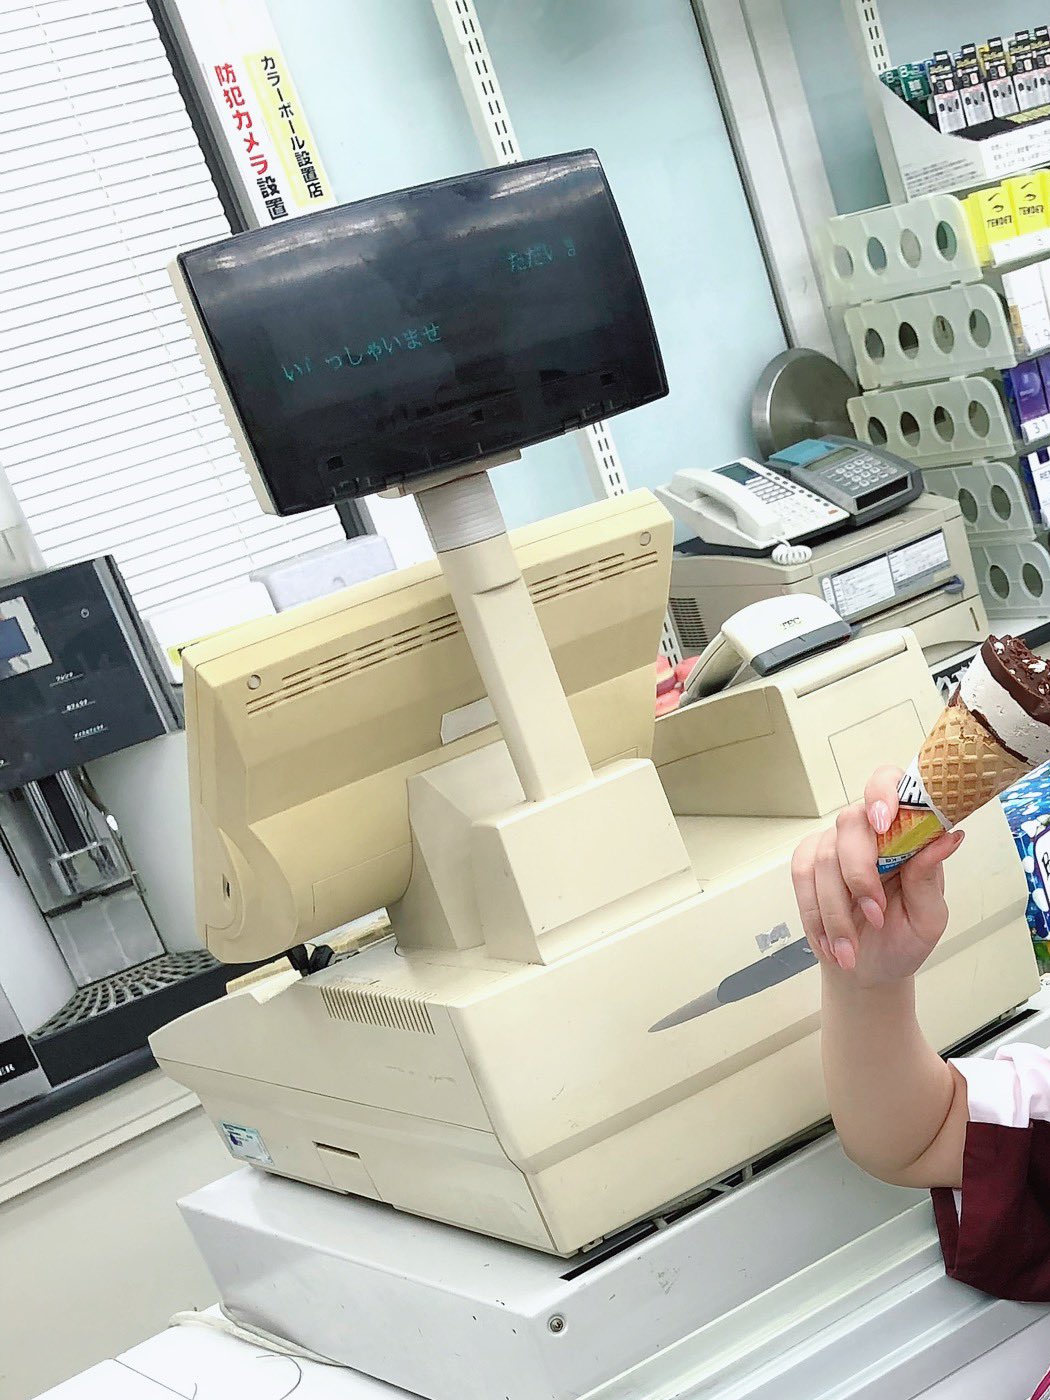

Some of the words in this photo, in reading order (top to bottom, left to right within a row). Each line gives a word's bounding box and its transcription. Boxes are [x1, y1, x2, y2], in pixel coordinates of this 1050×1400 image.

[214, 62, 289, 219] 防犯カメラ設置
[260, 55, 324, 199] カラーボール設置店
[1034, 328, 1050, 341] 19
[1034, 420, 1049, 434] 31
